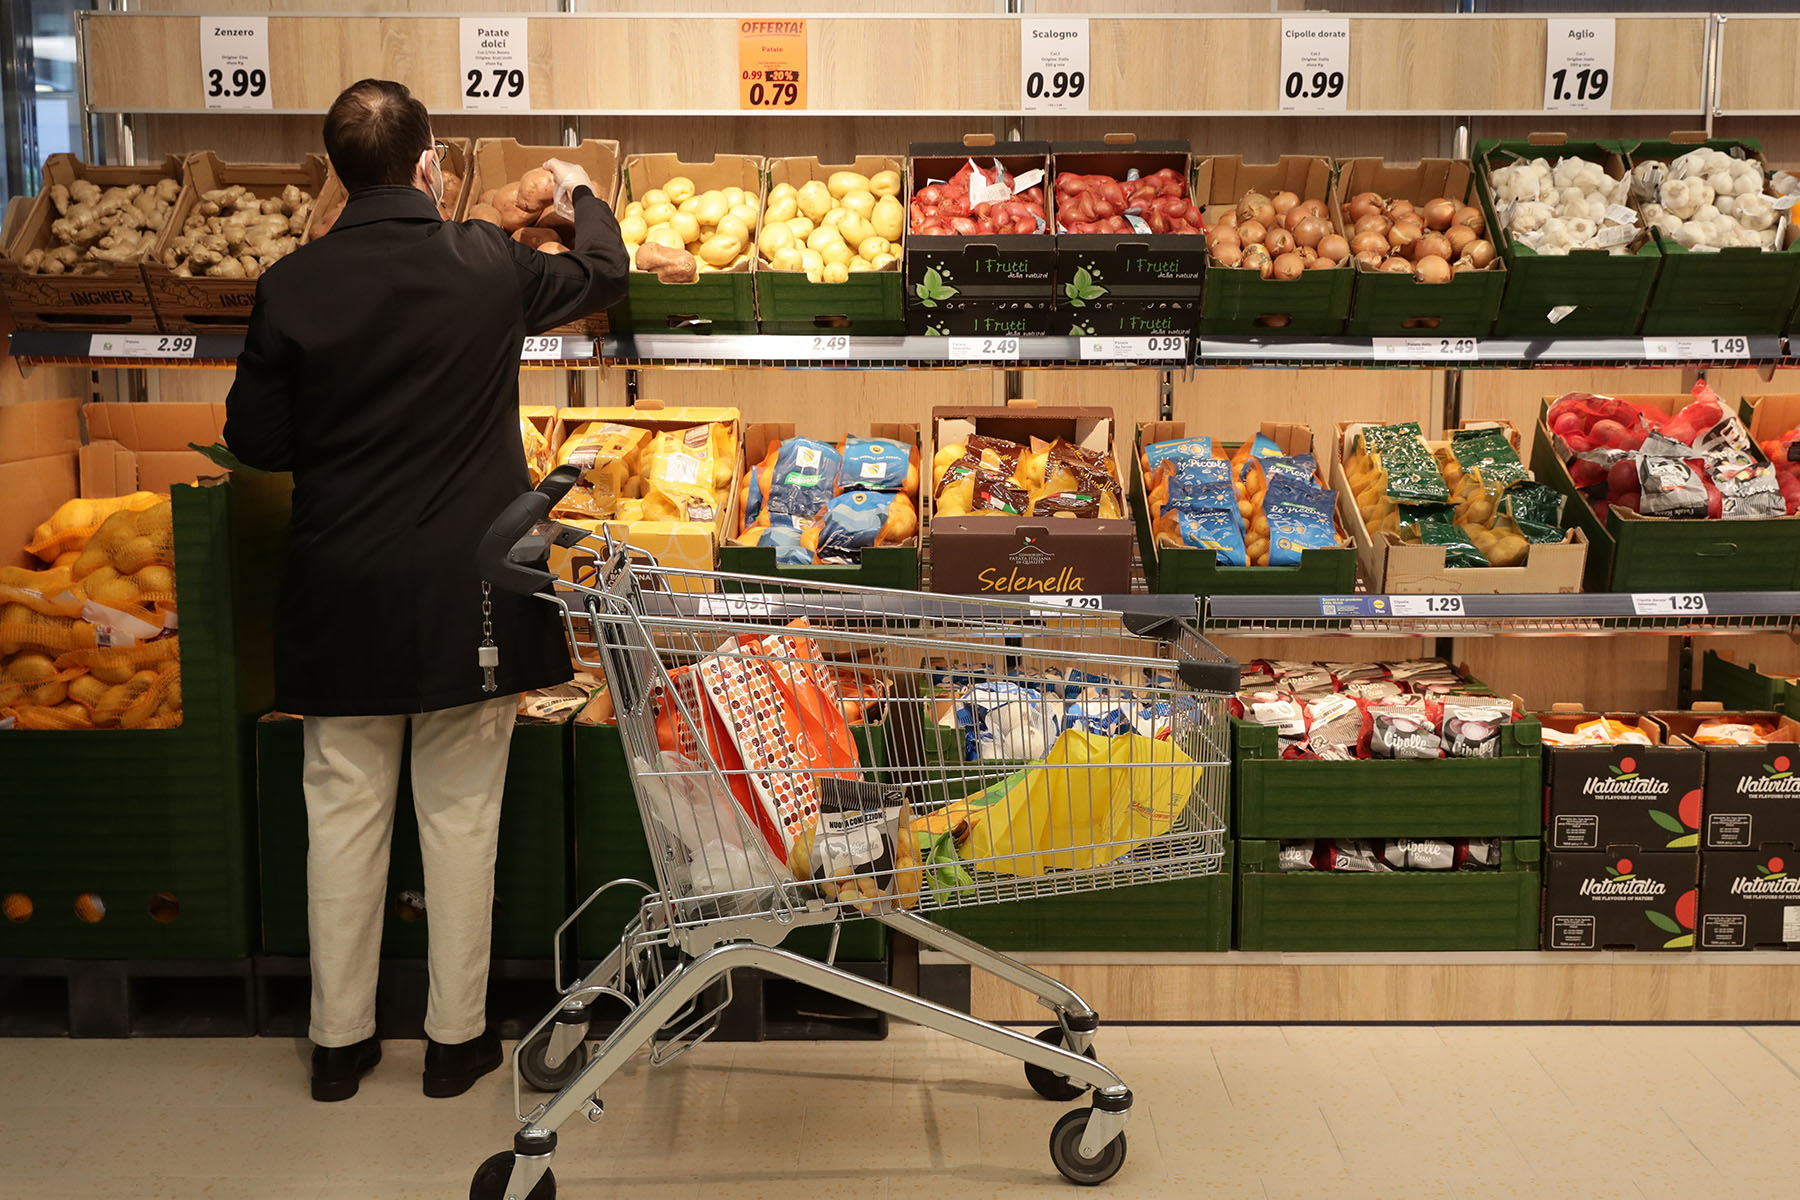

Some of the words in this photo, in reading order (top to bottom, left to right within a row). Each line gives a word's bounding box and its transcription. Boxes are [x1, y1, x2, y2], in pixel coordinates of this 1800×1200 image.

[214, 28, 254, 36] Zenzero
[478, 29, 510, 37] Patate
[742, 22, 803, 33] OFFERTA!
[1286, 30, 1316, 39] Cipolle
[1568, 29, 1594, 40] Aglio
[1032, 30, 1078, 40] Scalogno
[481, 40, 506, 48] dolci
[742, 70, 762, 80] 0.99
[770, 71, 793, 80] -20%
[208, 68, 266, 97] 3.99
[466, 69, 524, 98] 2.79
[1026, 72, 1084, 98] 0.99
[1286, 72, 1344, 98] 0.99
[1552, 69, 1608, 100] 1.19
[750, 83, 798, 106] 0.79
[985, 258, 1028, 272] Frutti
[1136, 258, 1180, 272] Frutti
[70, 289, 134, 306] INGWER
[984, 317, 1026, 332] Frutti
[1130, 316, 1172, 329] Frutti
[157, 338, 192, 352] 2.99
[524, 338, 558, 352] 2.99
[812, 337, 846, 350] 2.49
[982, 340, 1018, 354] 2.49
[1148, 338, 1182, 351] 0.99
[1440, 340, 1474, 354] 2.49
[1712, 338, 1744, 353] 1.49
[978, 566, 1084, 593] Selenella
[1426, 598, 1460, 612] 1.29
[1669, 596, 1704, 610] 1.29
[1384, 729, 1428, 750] Cipolle
[1582, 776, 1670, 794] Naturitalia
[850, 812, 886, 826] CONEZION
[1398, 838, 1441, 856] Cipolle
[1580, 878, 1666, 896] Naturitalia
